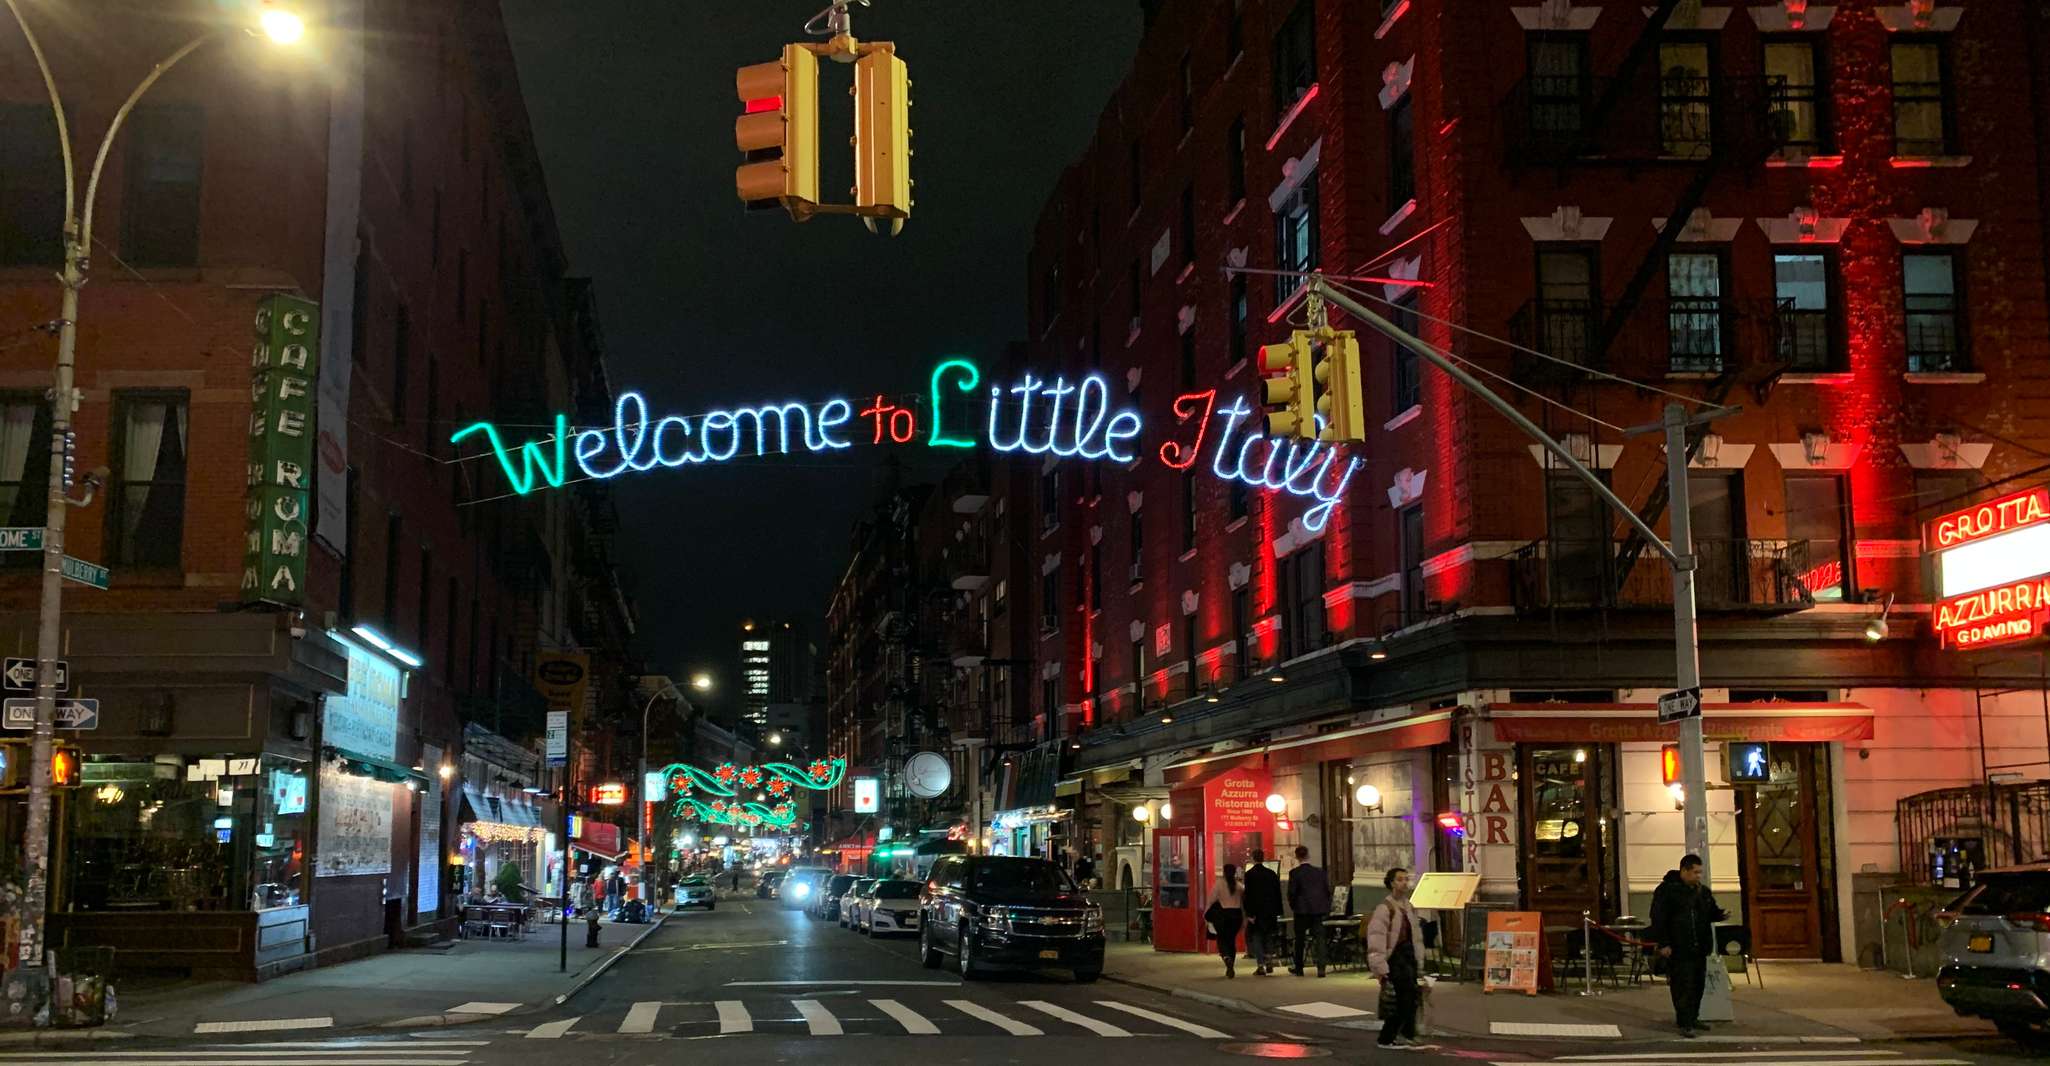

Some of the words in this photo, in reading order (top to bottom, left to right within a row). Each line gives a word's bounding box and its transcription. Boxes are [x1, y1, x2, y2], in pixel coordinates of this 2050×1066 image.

[278, 310, 309, 437] CAFE
[451, 392, 853, 495] Welcome
[860, 394, 915, 444] to
[927, 359, 1143, 463] Little
[271, 460, 302, 591] ROMA
[1937, 494, 2050, 546] GROTTA
[1935, 582, 2050, 630] AZZURRA
[1663, 701, 1675, 712] ONE
[1680, 698, 1693, 711] WAY
[1536, 763, 1580, 775] CAFE
[1770, 761, 1792, 774] AR
[1221, 790, 1258, 798] Azzurra
[1224, 779, 1255, 788] Grotta
[1483, 752, 1511, 844] BAR
[1215, 799, 1265, 809] Ristorante
